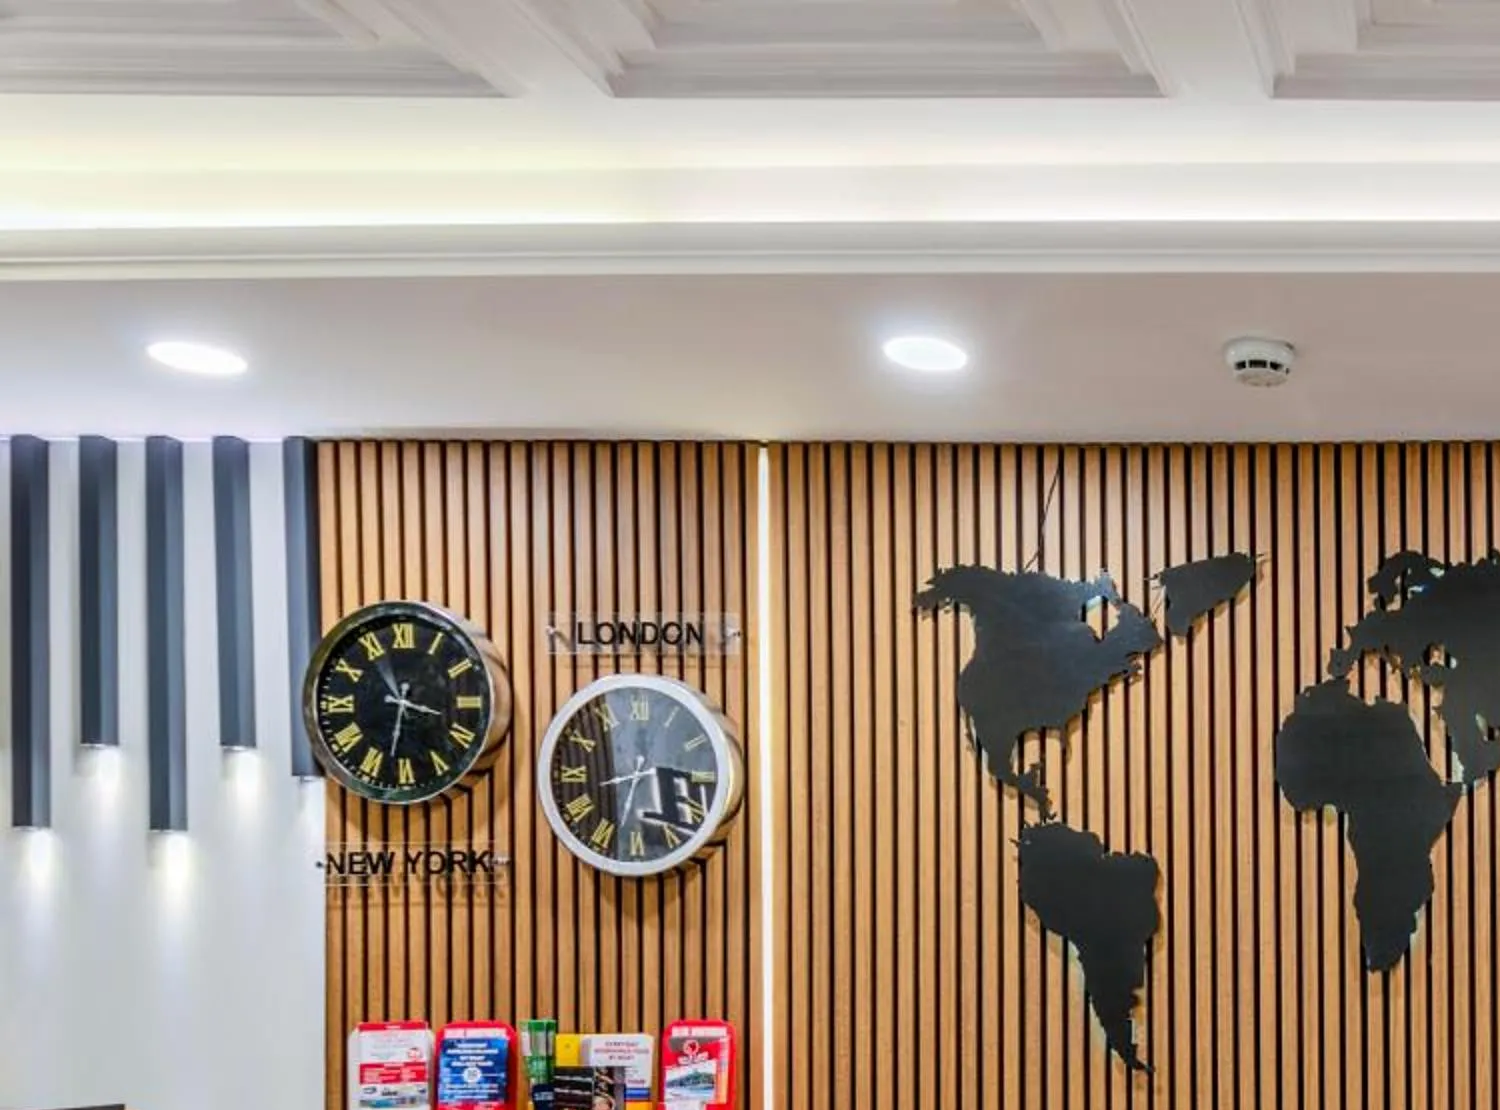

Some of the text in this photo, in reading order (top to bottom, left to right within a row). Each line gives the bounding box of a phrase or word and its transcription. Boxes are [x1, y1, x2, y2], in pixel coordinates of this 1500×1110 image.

[577, 621, 704, 645] LONDON
[326, 851, 490, 875] NEW YORK
